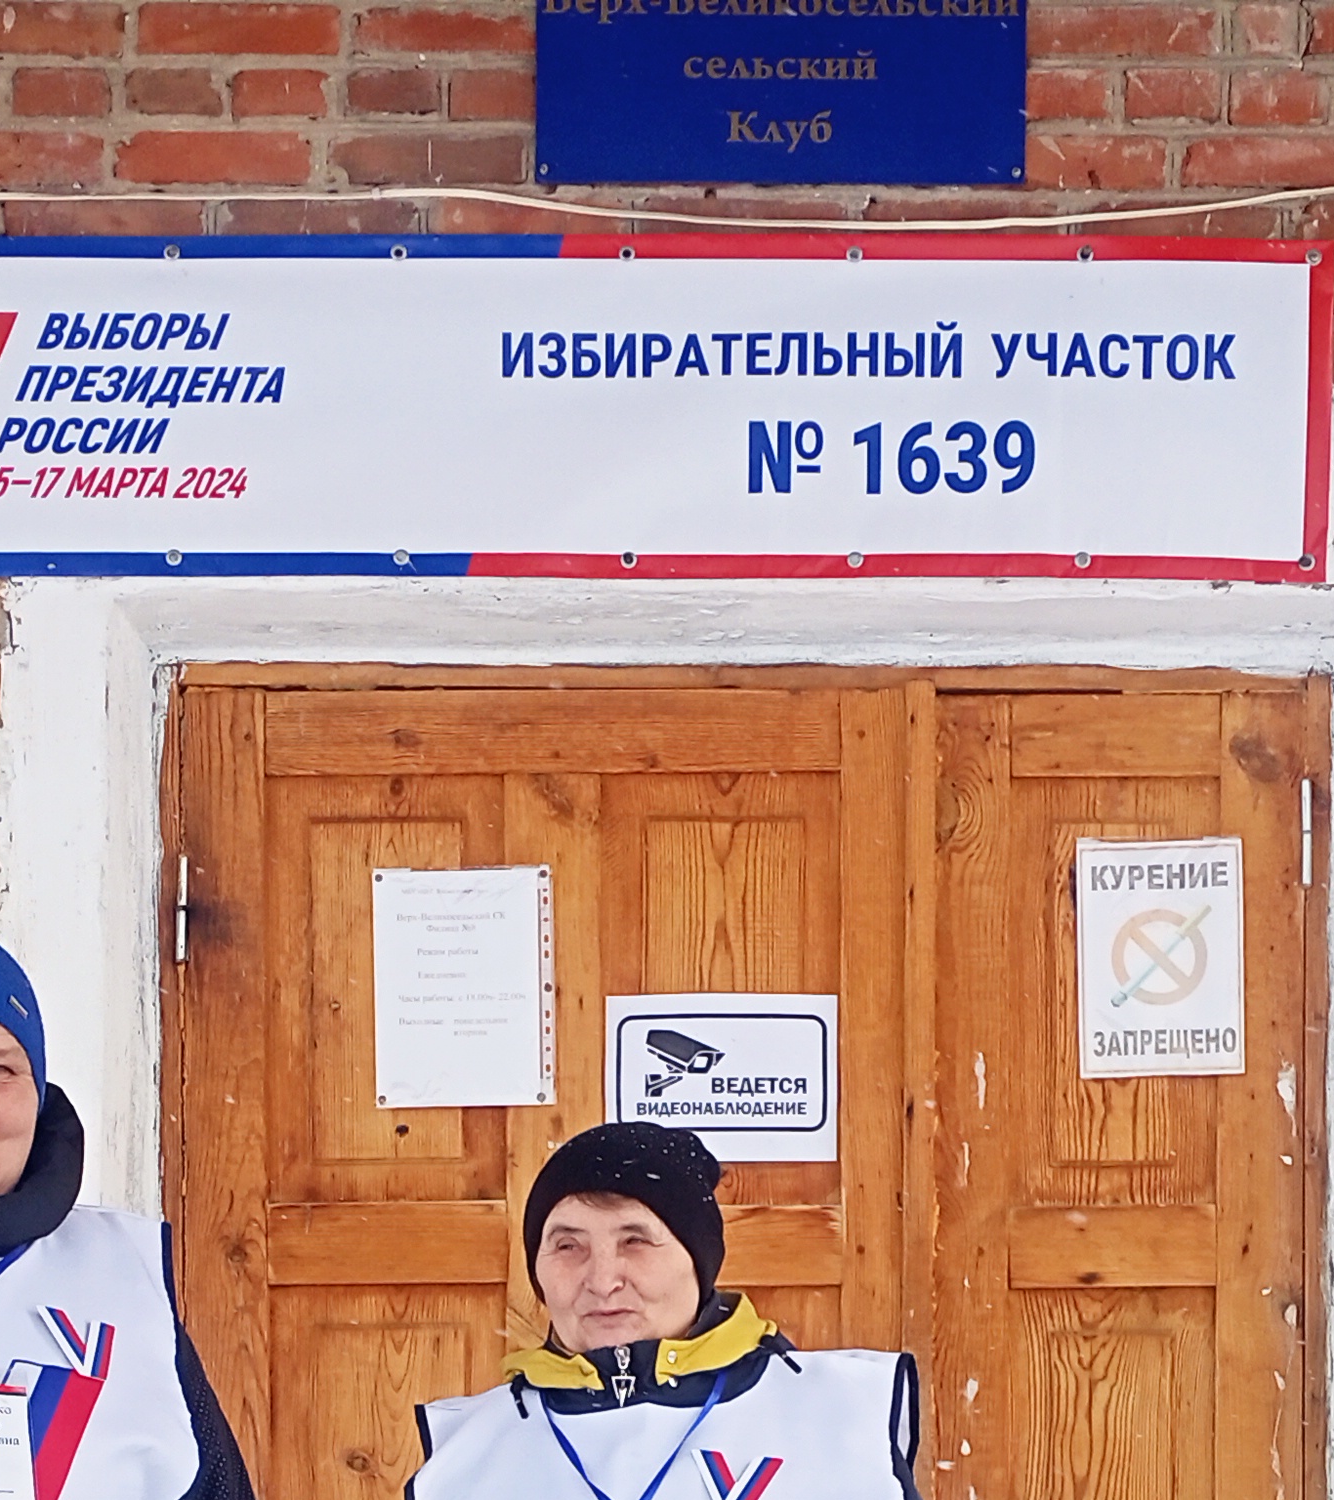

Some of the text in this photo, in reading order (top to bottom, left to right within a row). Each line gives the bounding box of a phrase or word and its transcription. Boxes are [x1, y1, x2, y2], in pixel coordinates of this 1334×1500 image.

[683, 50, 878, 80] сельский
[726, 109, 833, 152] Клуб
[37, 312, 231, 351] ВЫБОРЫ
[500, 321, 1236, 380] ИЗБИРАТЕЛЬНЫЙ УЧАСТОК
[15, 366, 286, 408] ПРЕЗИДЕНТА
[747, 420, 1038, 495] № 1639
[66, 468, 167, 499] МАРТА
[173, 467, 249, 500] 2024
[1091, 861, 1228, 891] КУРЕНИЕ
[1093, 1027, 1237, 1058] ЗАПРЕЩЕНО
[711, 1077, 807, 1097] ВЕДЕТСЯ
[636, 1102, 807, 1117] ВИДЕОНАБЛЮДЕНИЕ
